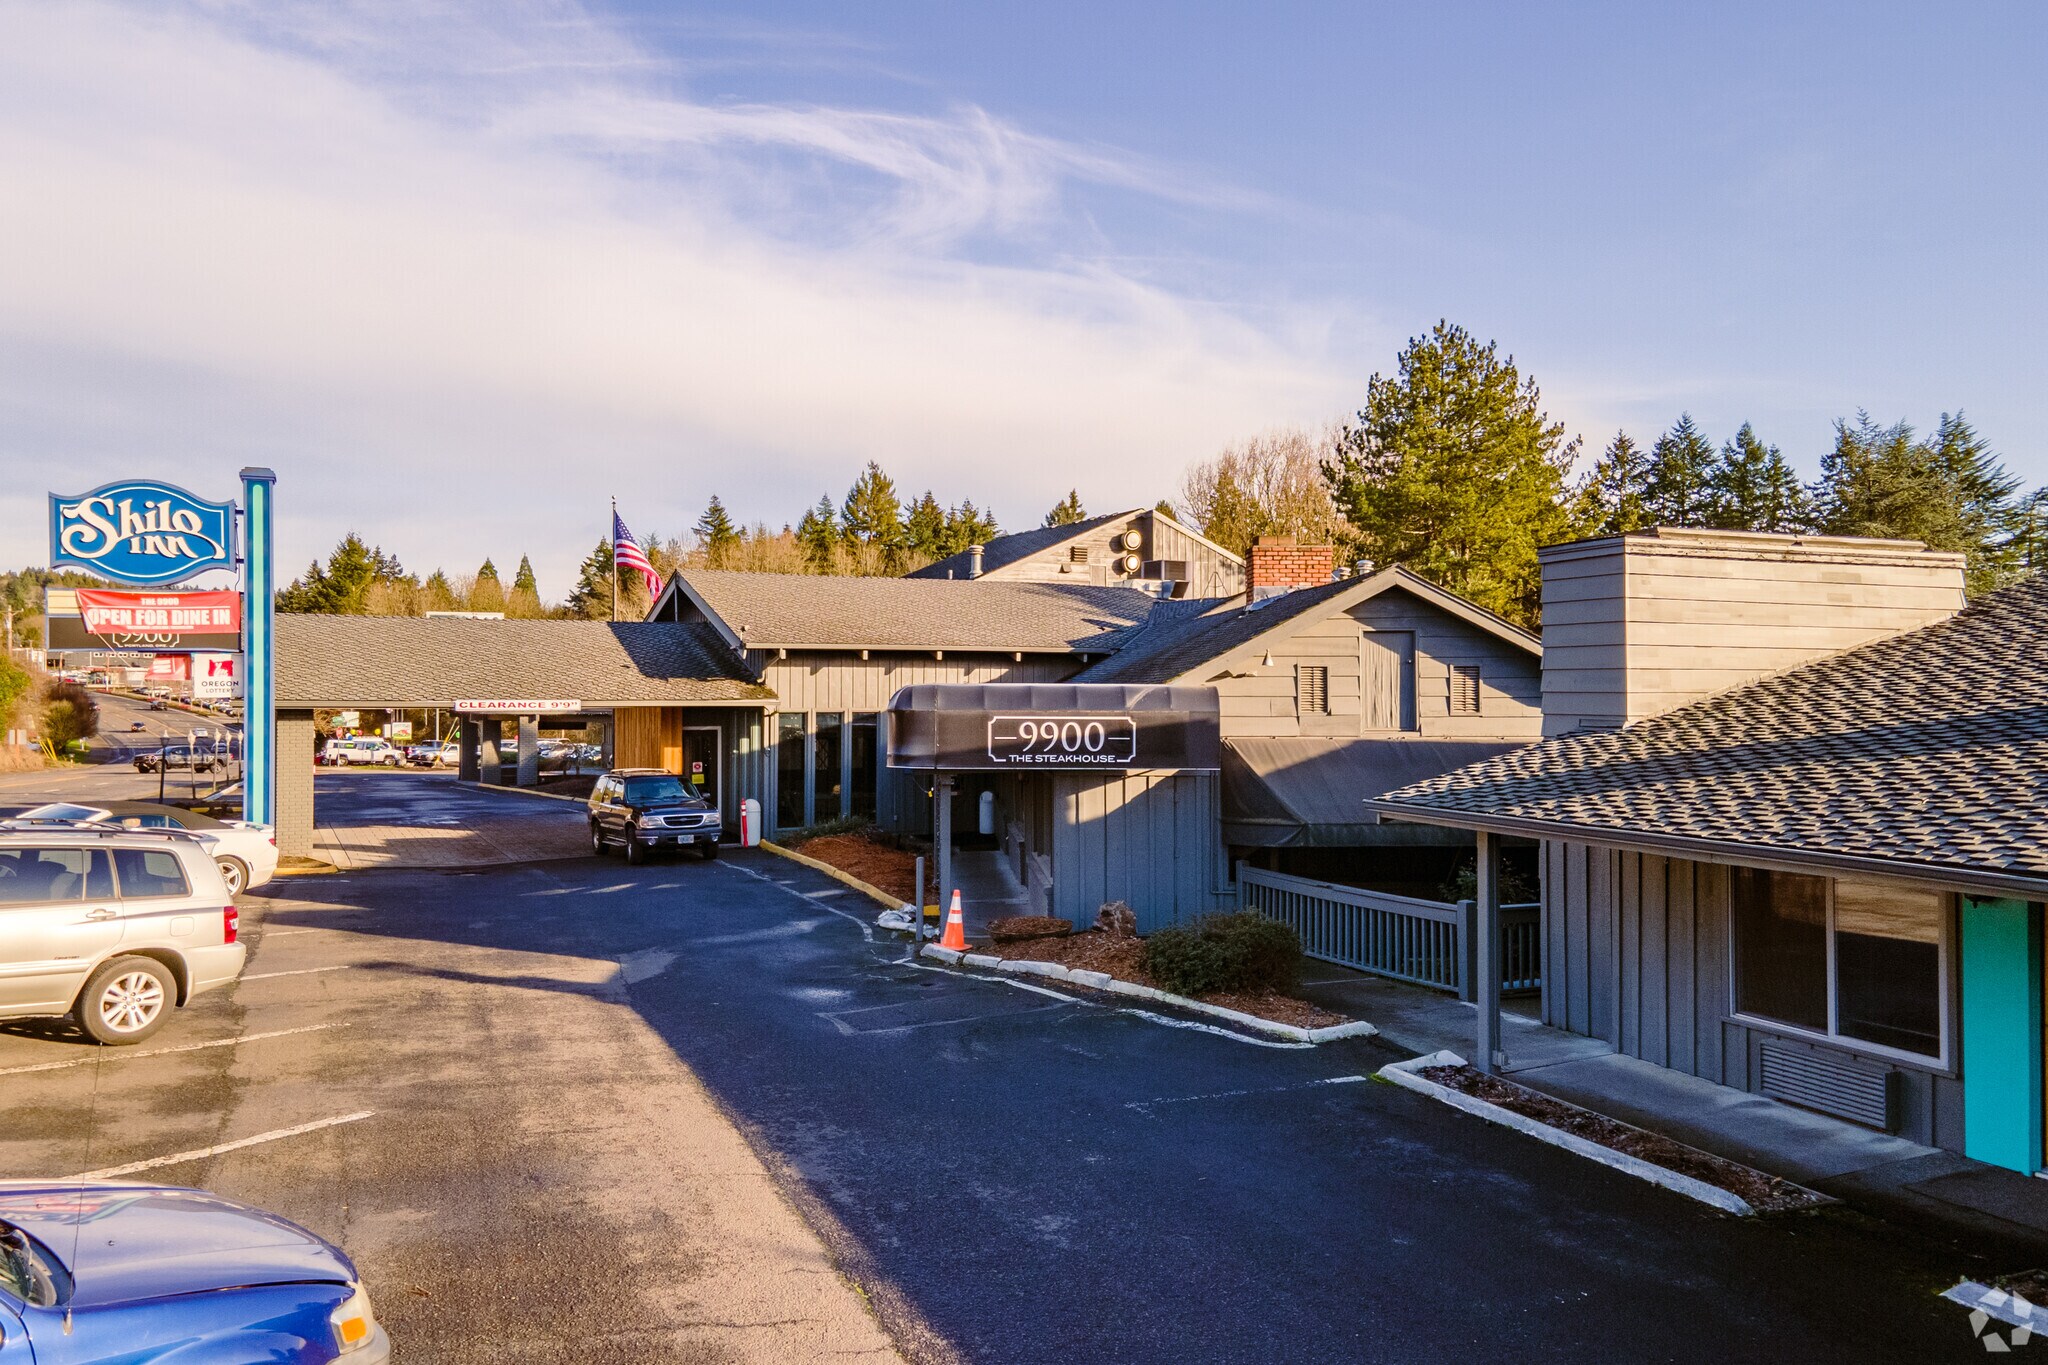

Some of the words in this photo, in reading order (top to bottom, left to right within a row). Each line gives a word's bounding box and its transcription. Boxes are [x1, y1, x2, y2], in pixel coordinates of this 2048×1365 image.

[61, 497, 226, 560] Shilo
[87, 608, 132, 626] OPEN
[136, 608, 169, 626] FOR
[171, 608, 210, 626] DINE
[213, 608, 231, 625] IN
[459, 701, 546, 709] CLEARANCE
[1019, 721, 1105, 752] 9900
[1008, 754, 1033, 763] THE
[1034, 754, 1116, 763] STEAKHOUSE
